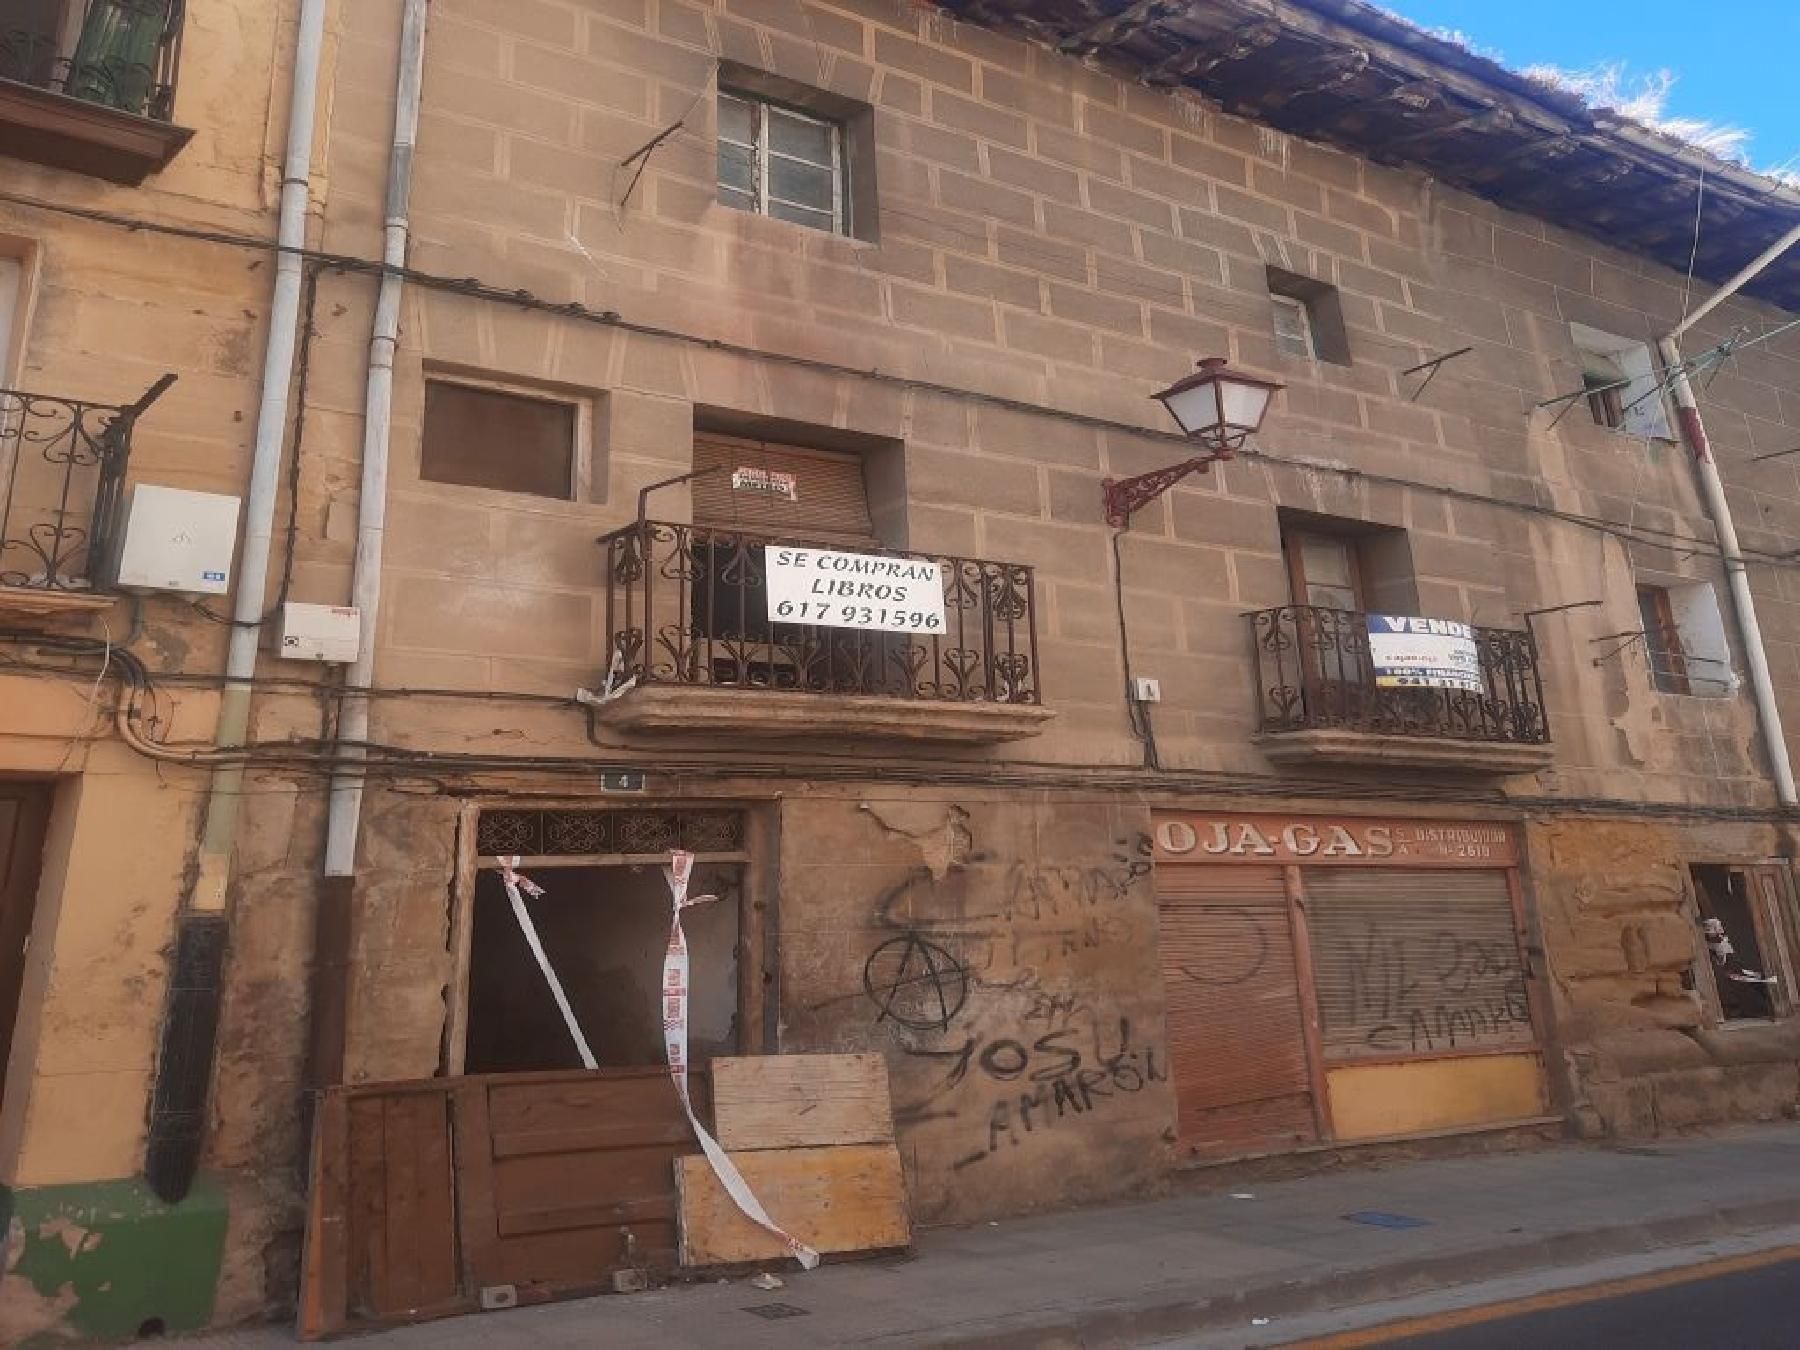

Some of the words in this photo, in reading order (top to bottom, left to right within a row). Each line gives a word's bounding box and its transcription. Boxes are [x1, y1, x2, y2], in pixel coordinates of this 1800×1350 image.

[776, 551, 809, 568] SE
[816, 555, 934, 582] COMPRAN
[811, 578, 908, 602] LIBROS
[776, 600, 831, 620] 617
[841, 606, 940, 629] 931596
[618, 774, 629, 788] 4
